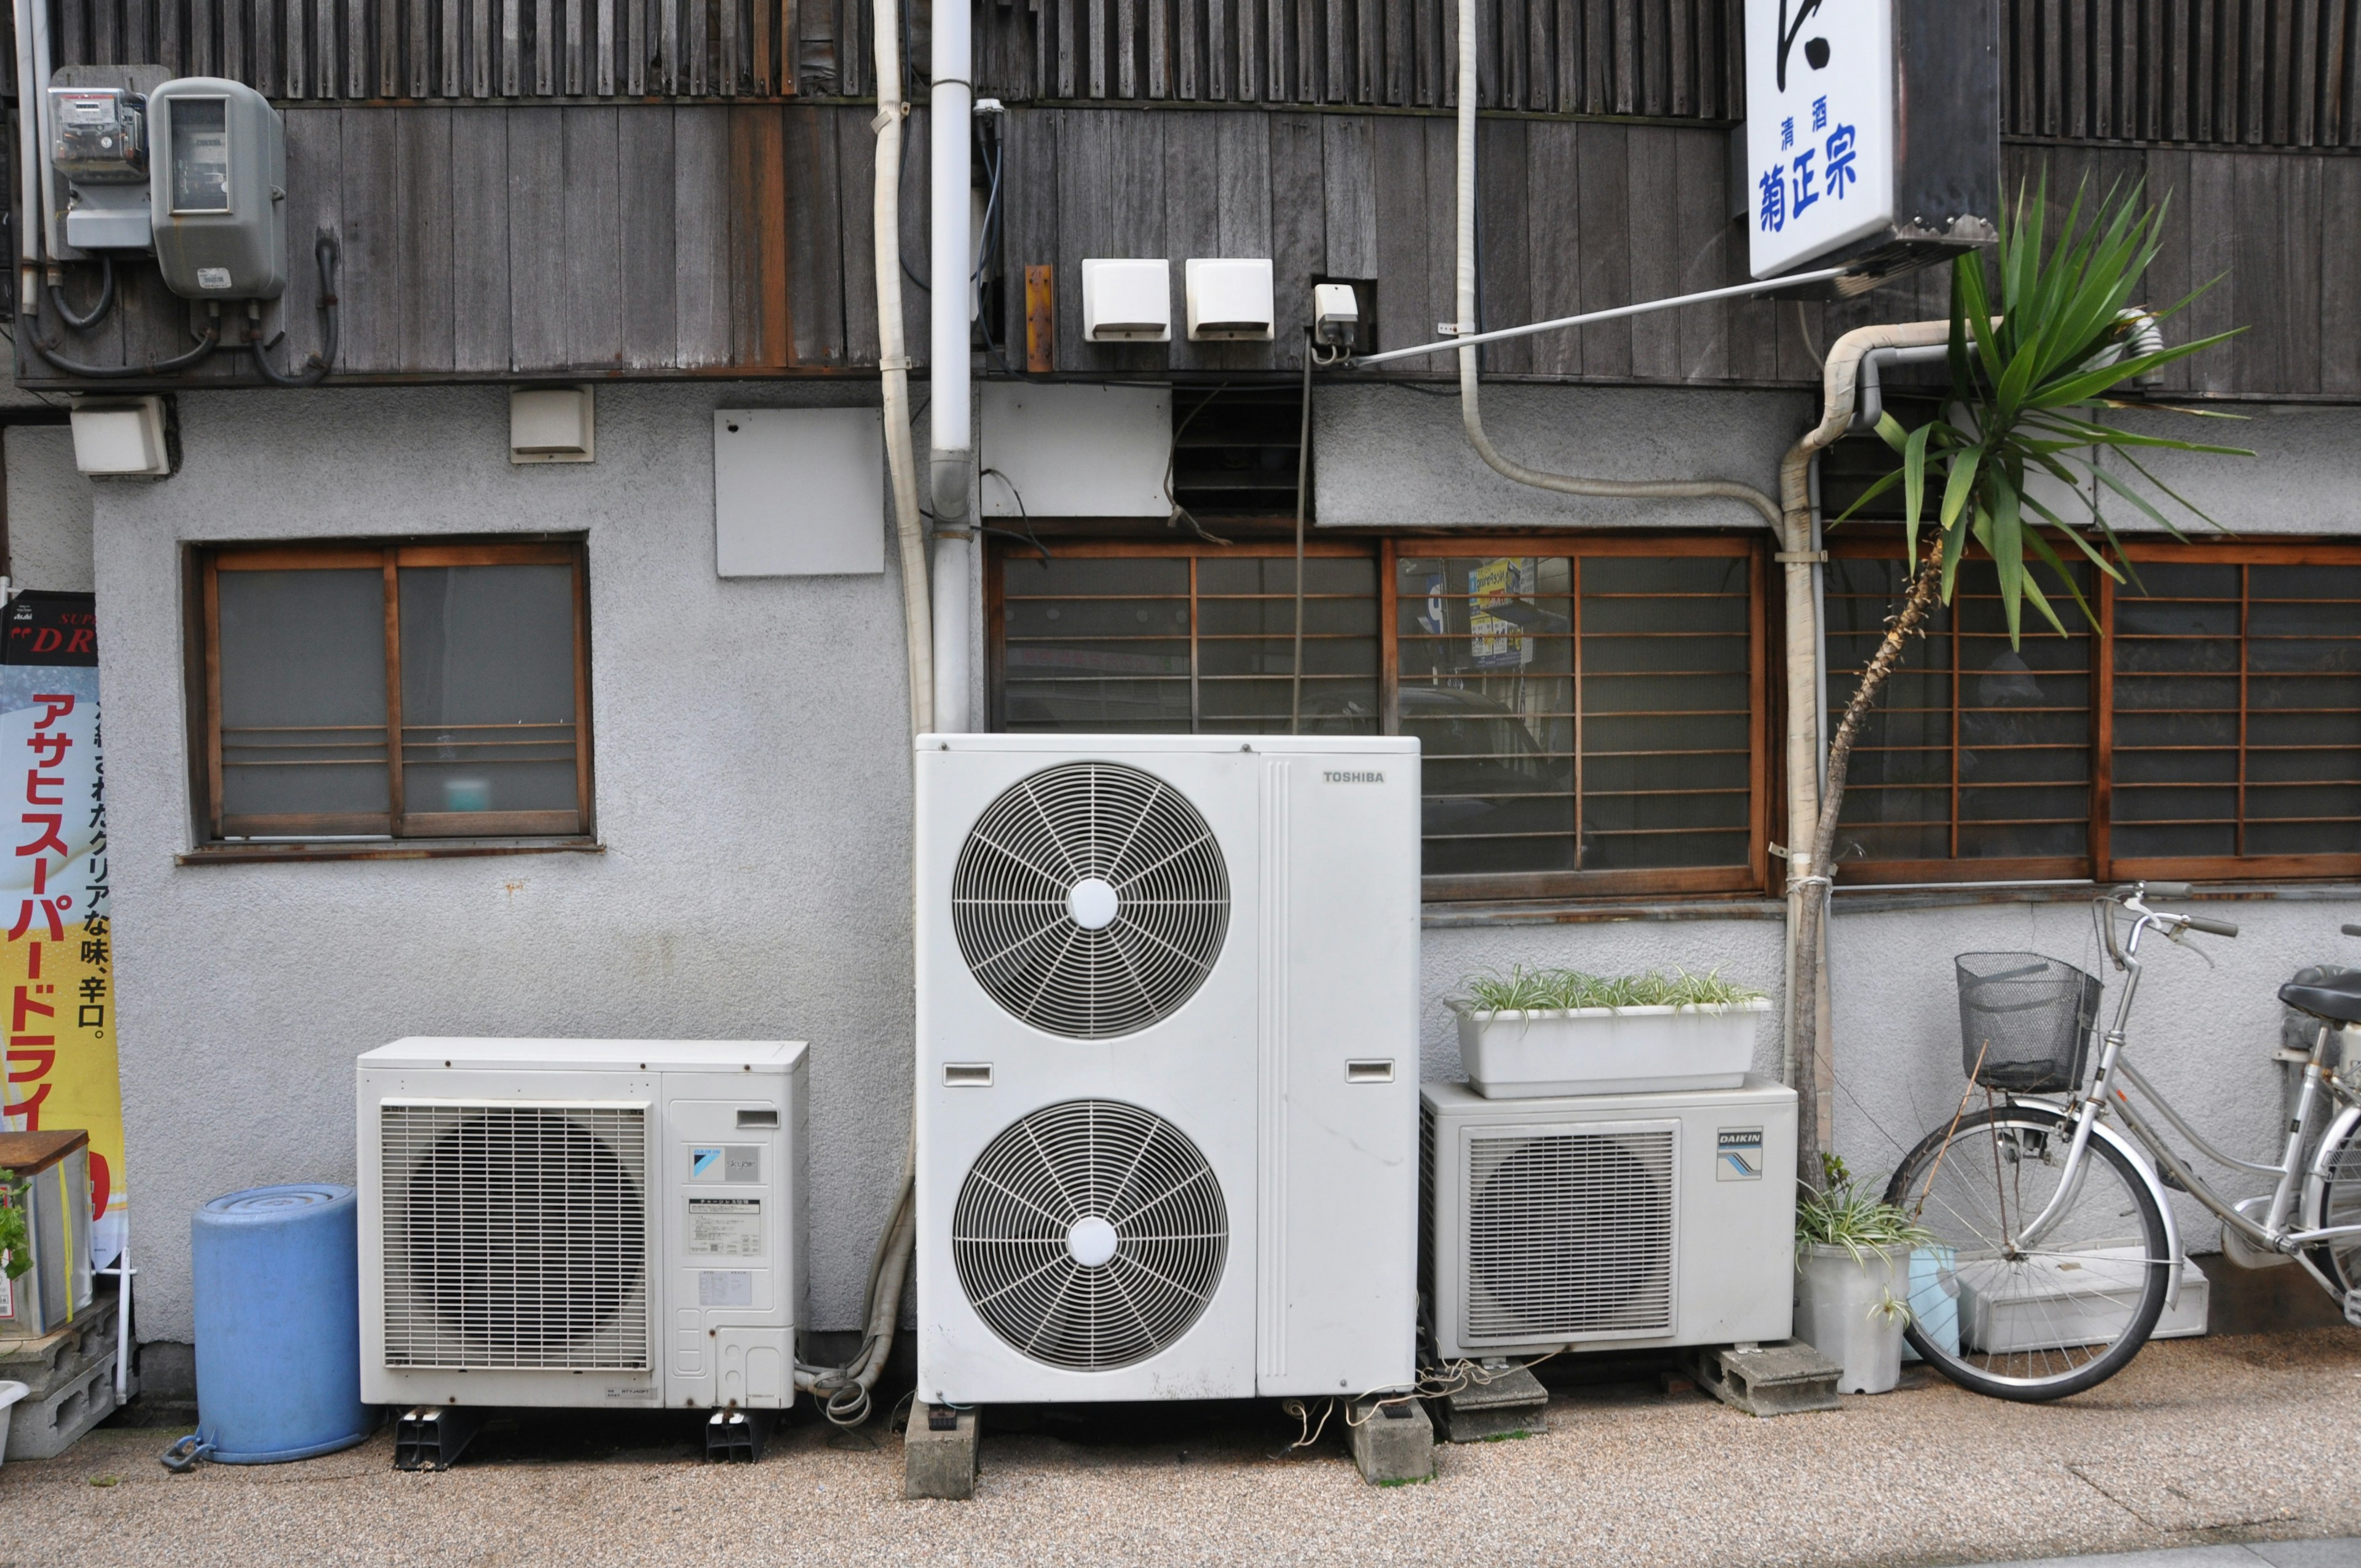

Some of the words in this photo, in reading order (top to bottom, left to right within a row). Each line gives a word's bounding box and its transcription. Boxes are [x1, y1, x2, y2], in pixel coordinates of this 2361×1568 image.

[1781, 94, 1827, 152] 清酒
[1759, 122, 1856, 233] 菊正宗
[59, 613, 97, 625] SUP
[1323, 772, 1384, 782] TOSHIBA
[3, 694, 76, 1132] アサヒスーパードライ
[1719, 1134, 1761, 1144] DAIKIN
